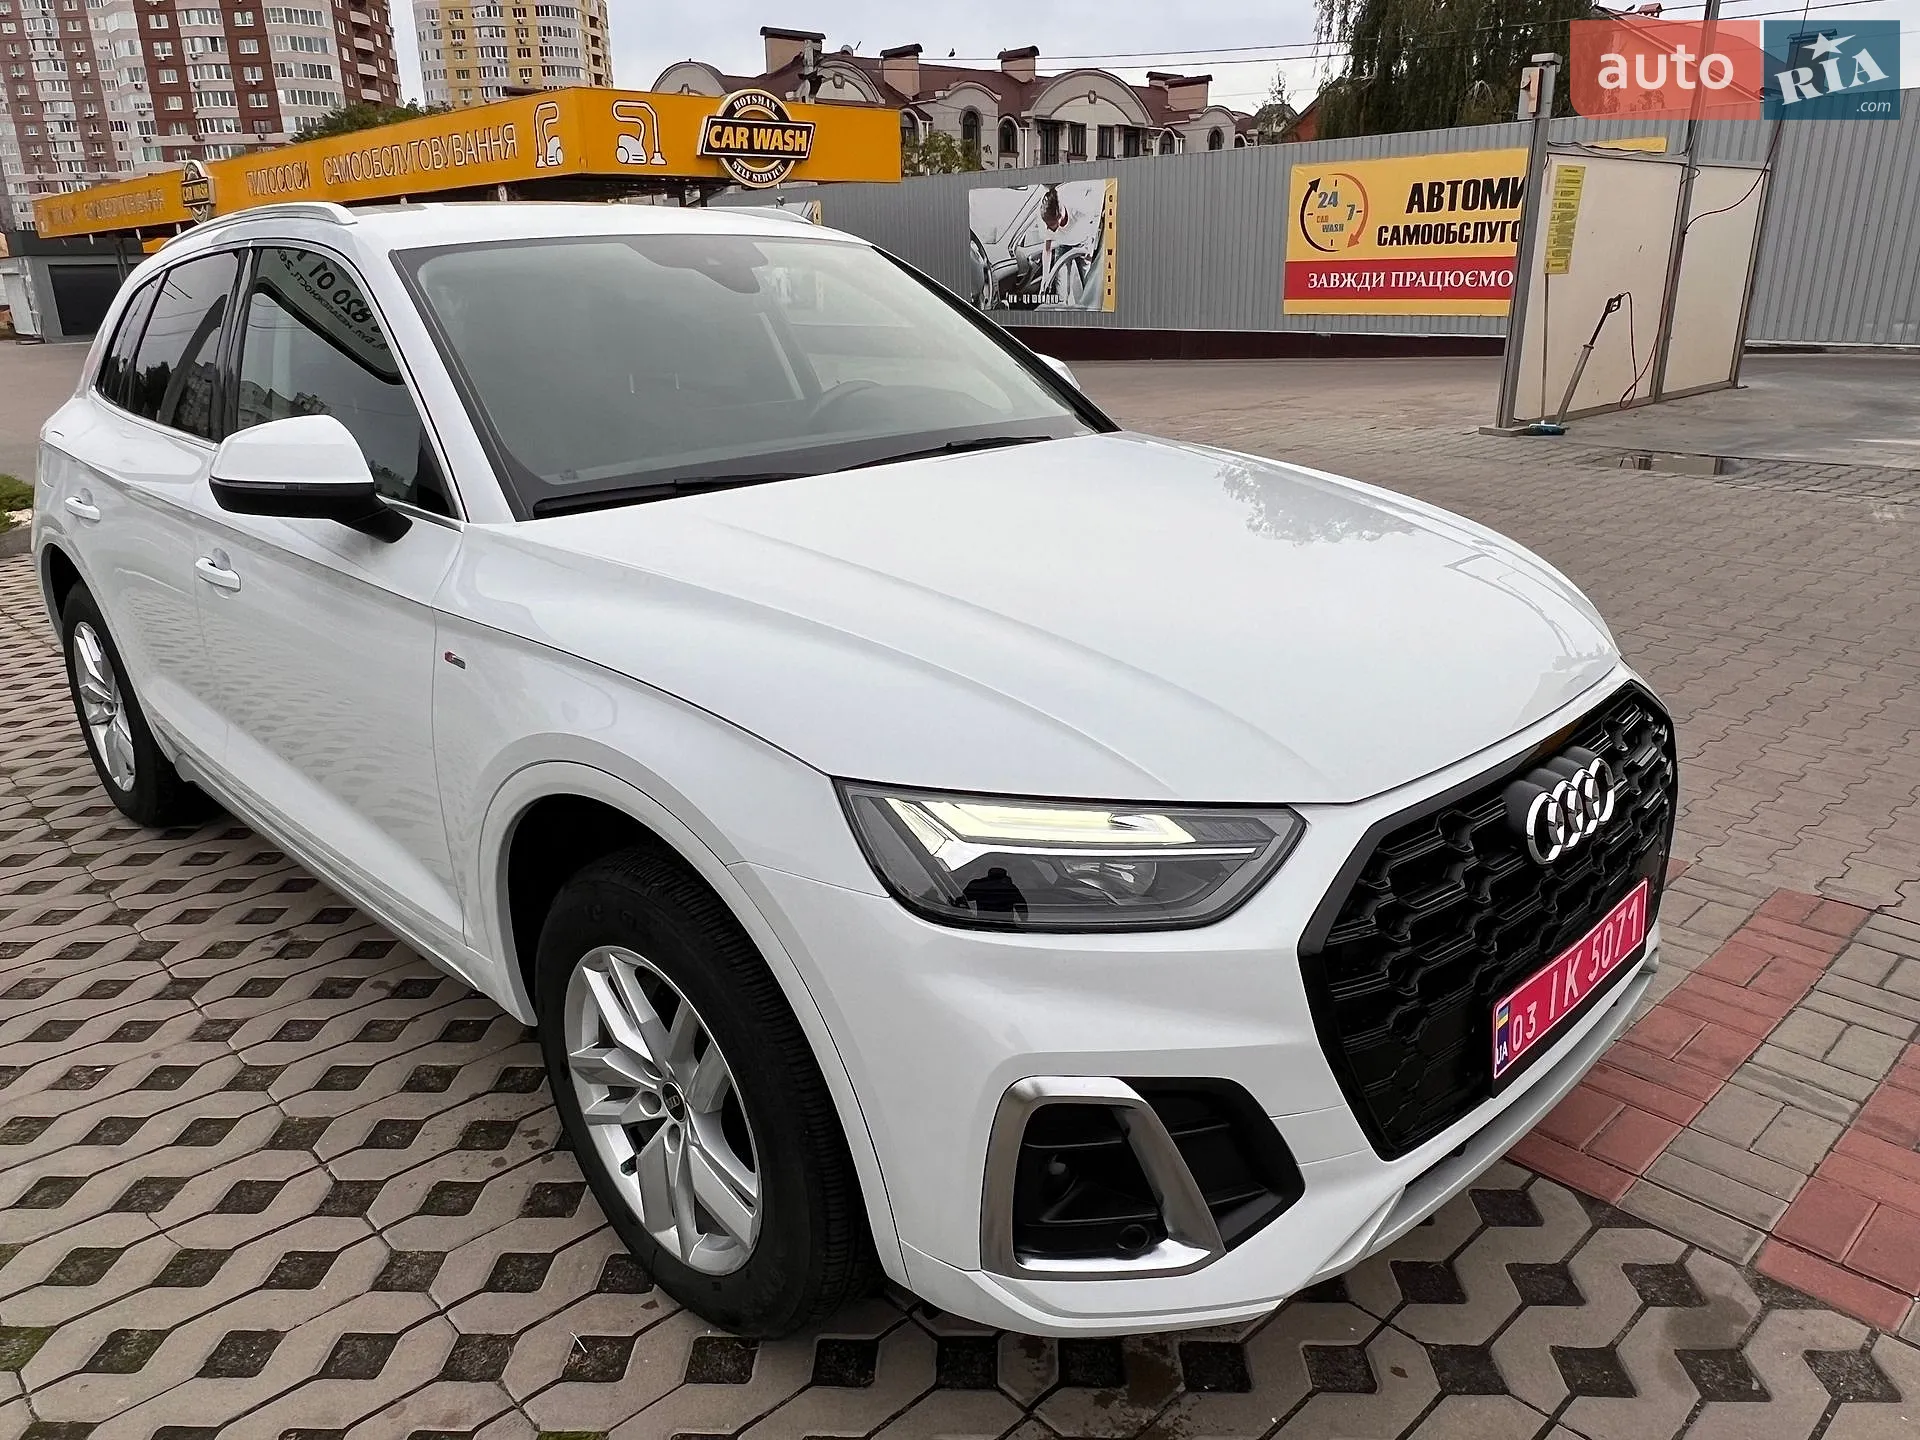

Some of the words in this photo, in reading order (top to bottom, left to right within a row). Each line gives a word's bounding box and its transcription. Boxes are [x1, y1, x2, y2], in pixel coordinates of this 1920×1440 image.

[709, 125, 750, 149] CAR
[753, 127, 808, 152] WASH
[322, 123, 519, 186] САМООБСЛУГОВУВАННЯ
[731, 160, 752, 180] SELF
[751, 163, 786, 184] SERVICE
[1317, 191, 1339, 209] 24
[1346, 203, 1356, 221] 7
[1308, 271, 1386, 292] ЗАВЖДИ
[1391, 270, 1514, 291] ПРАЦЮЄМО
[1512, 1001, 1537, 1052] 03
[1588, 896, 1640, 982] 5071
[1496, 1041, 1508, 1065] UA
